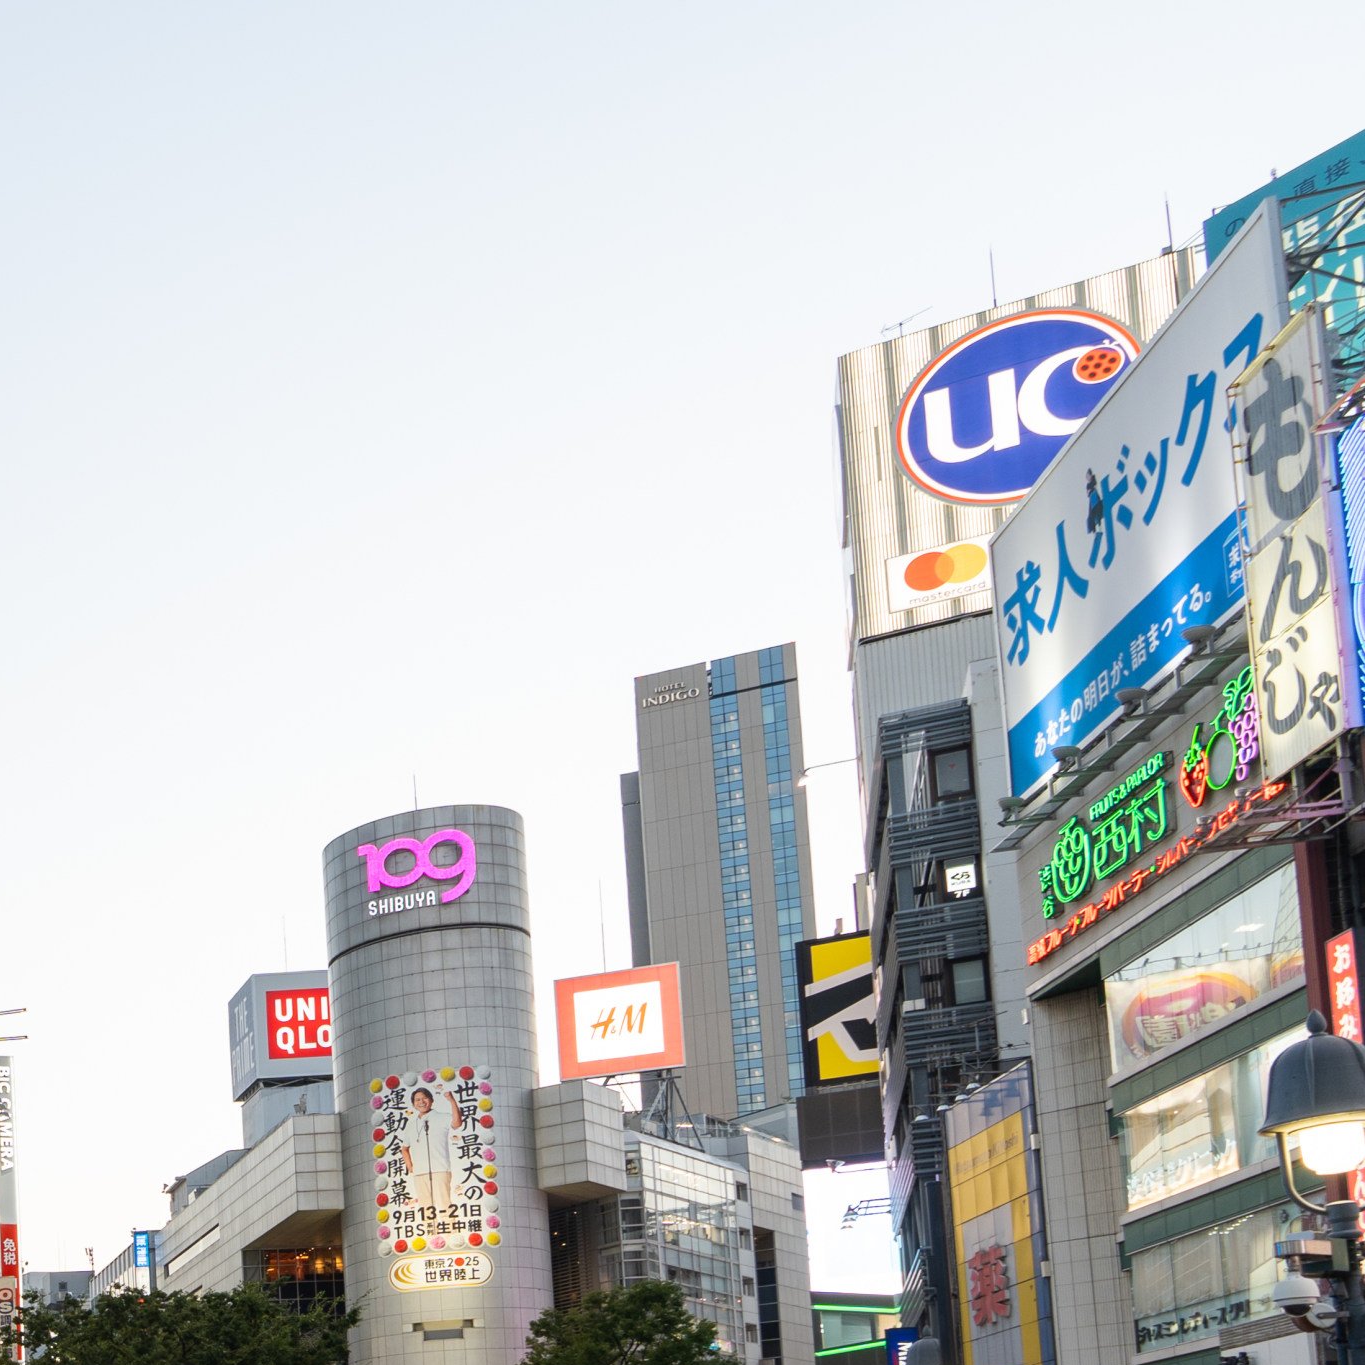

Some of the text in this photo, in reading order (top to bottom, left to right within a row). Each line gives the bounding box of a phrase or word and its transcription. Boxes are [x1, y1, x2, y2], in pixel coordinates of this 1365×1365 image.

[1243, 358, 1341, 736] もんじゃ
[909, 581, 987, 605] mastercard
[655, 681, 686, 693] HOTEL
[1034, 583, 1213, 758] あなたの明日が、詰まってる。
[641, 687, 700, 708] INDIGO
[1092, 778, 1167, 880] 西村
[357, 829, 477, 904] 109
[368, 890, 436, 916] SHIBUYA
[1037, 864, 1055, 919] 渋谷
[274, 996, 329, 1022] UNI
[590, 1001, 648, 1040] H&M
[275, 1024, 332, 1054] QLO
[382, 1087, 412, 1208] 運動会開幕
[454, 1081, 488, 1201] 世界最大の
[394, 1224, 426, 1239] TBS
[2, 1238, 17, 1266] 免税
[425, 1268, 481, 1284] 世界陸上
[968, 1245, 1010, 1327] 薬
